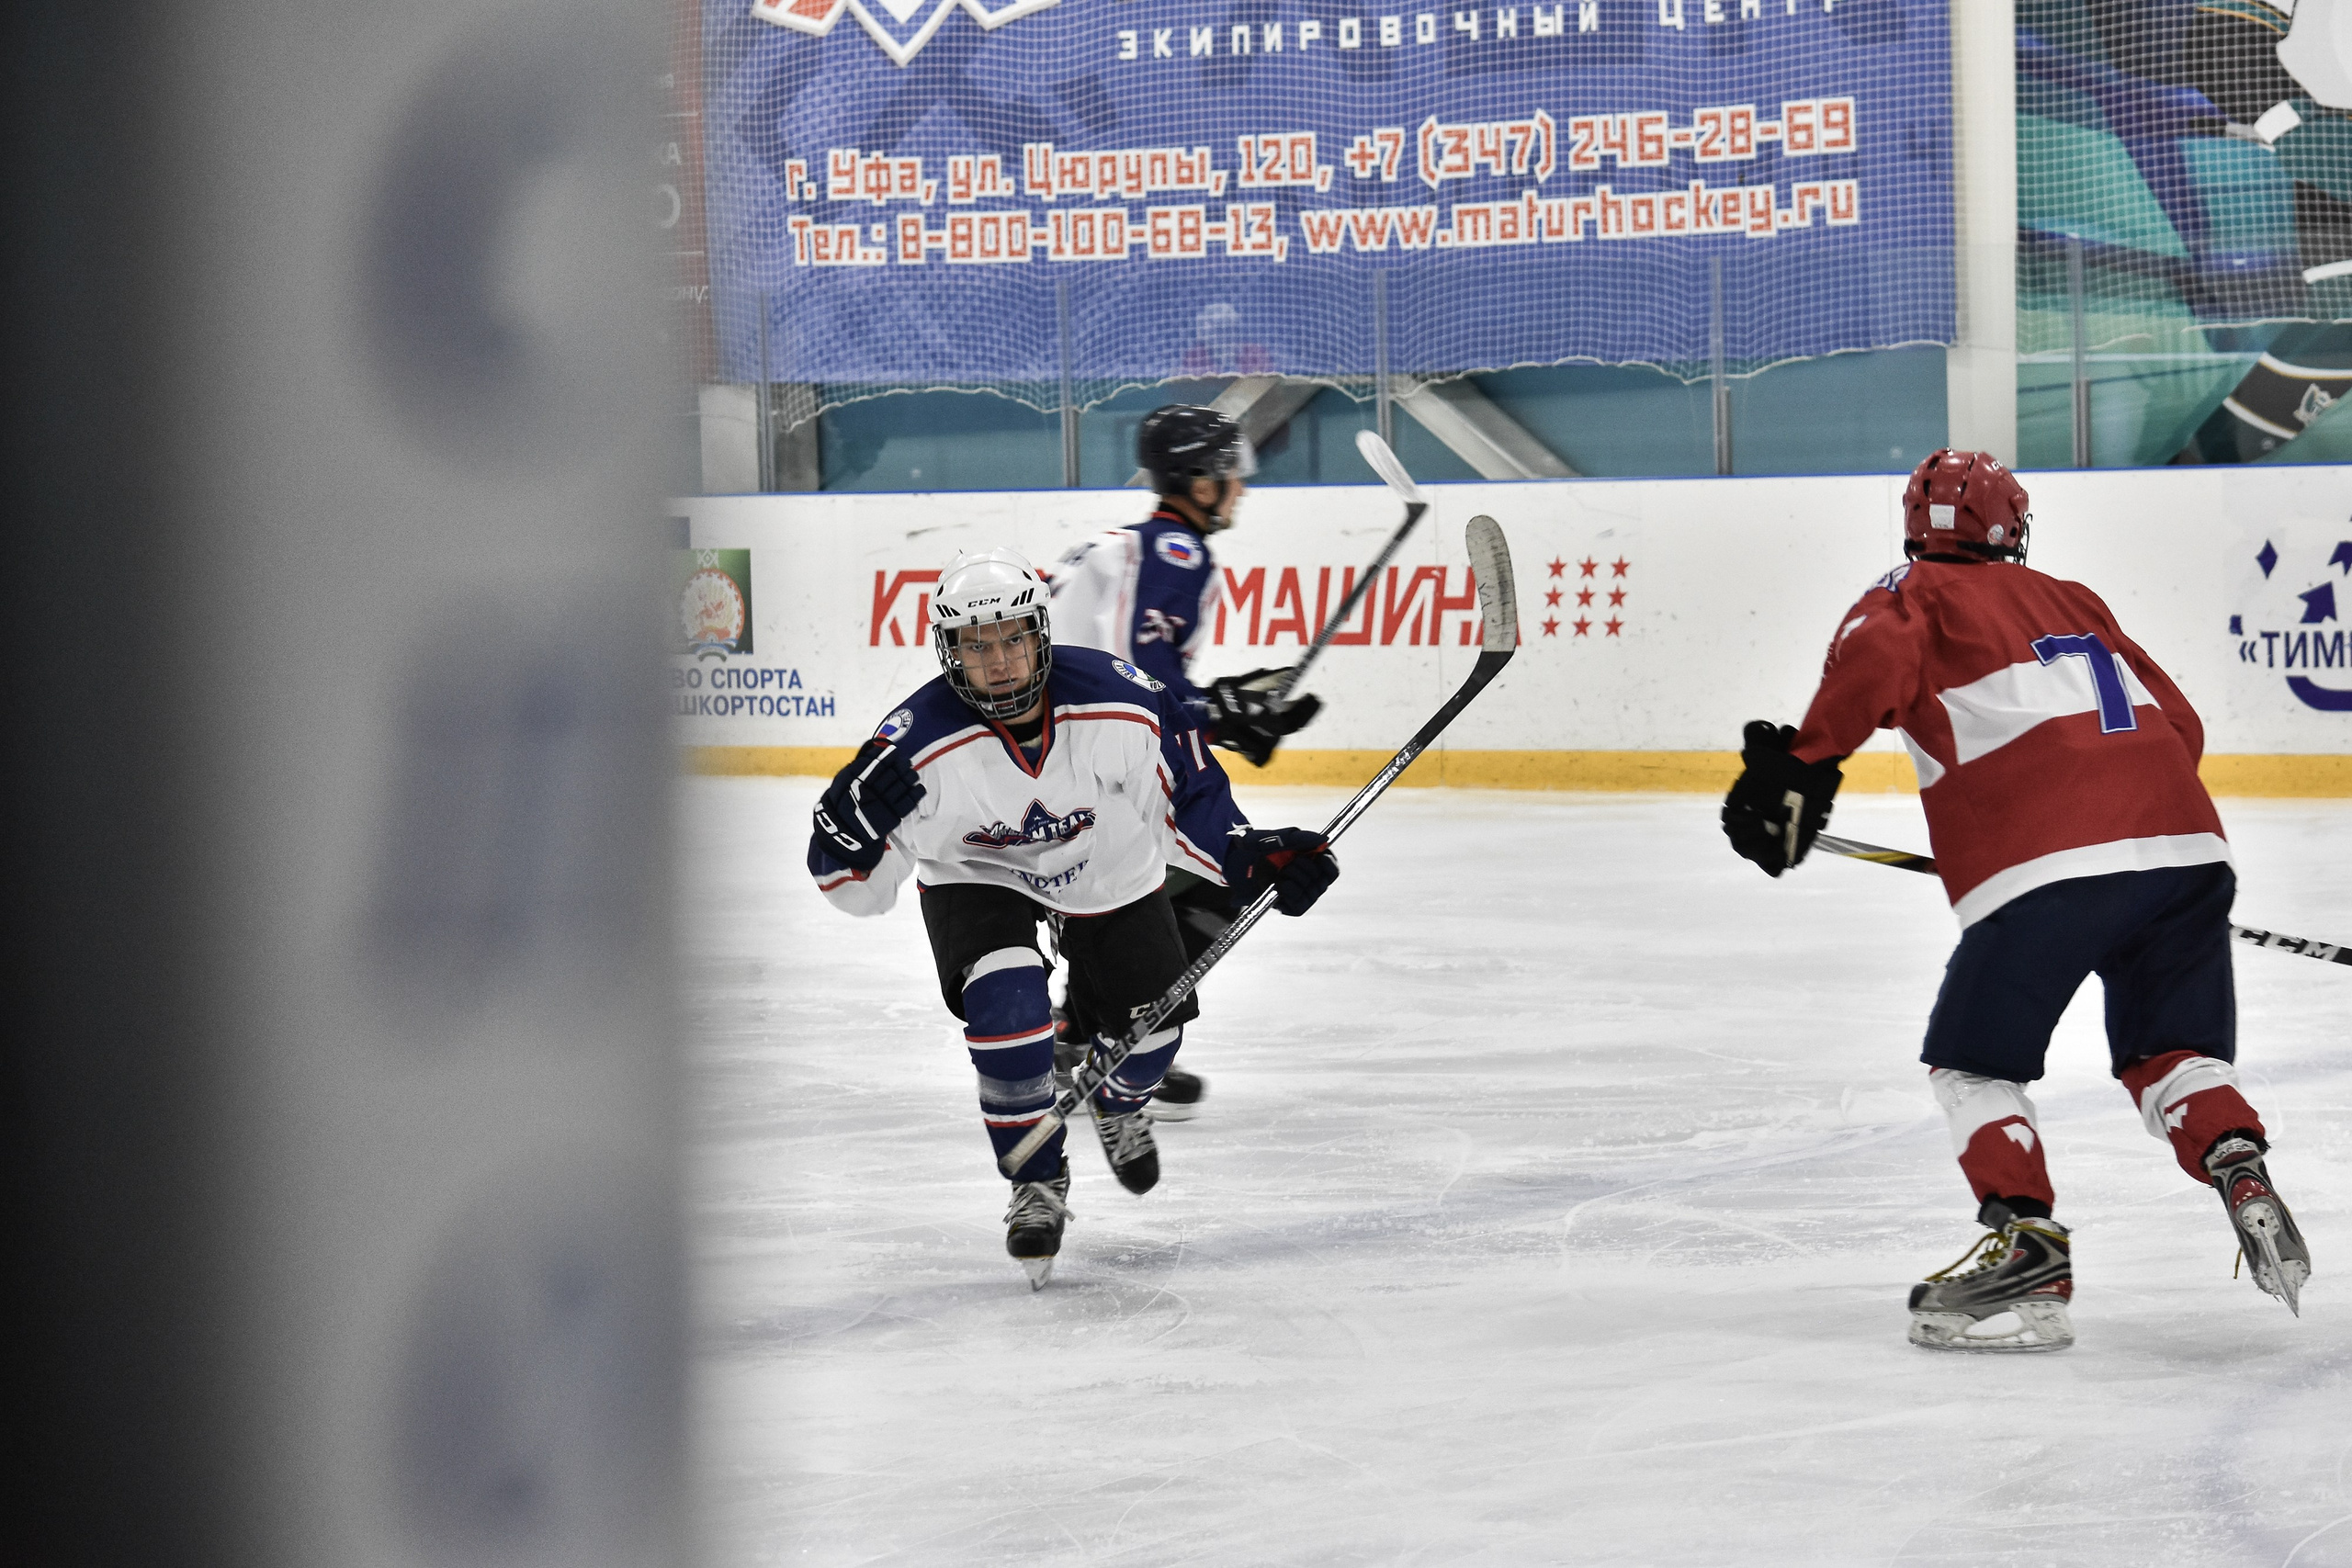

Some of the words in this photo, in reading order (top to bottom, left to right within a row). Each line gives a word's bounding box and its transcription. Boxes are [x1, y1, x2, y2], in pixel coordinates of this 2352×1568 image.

[1117, 0, 1600, 61] ЭКИПИРОВОЧНЫЙ
[785, 157, 818, 203] г.
[827, 148, 939, 206] Уфа,
[948, 153, 1016, 204] ул.
[1023, 142, 1228, 200] Цюрупы,
[1238, 131, 1334, 193] 120,
[1343, 127, 1405, 182] +7
[1417, 107, 1557, 190] (347)
[1568, 96, 1856, 170] 246-28-69
[787, 215, 888, 266] Тел.:
[896, 202, 1290, 263] 8-800-100-68-13,
[1300, 178, 1860, 253] www.maturhockey.ru
[967, 597, 1001, 609] CCM
[676, 694, 836, 716] ШКОРТОСТАН
[710, 668, 803, 690] СПОРТА
[2030, 632, 2138, 734] 7
